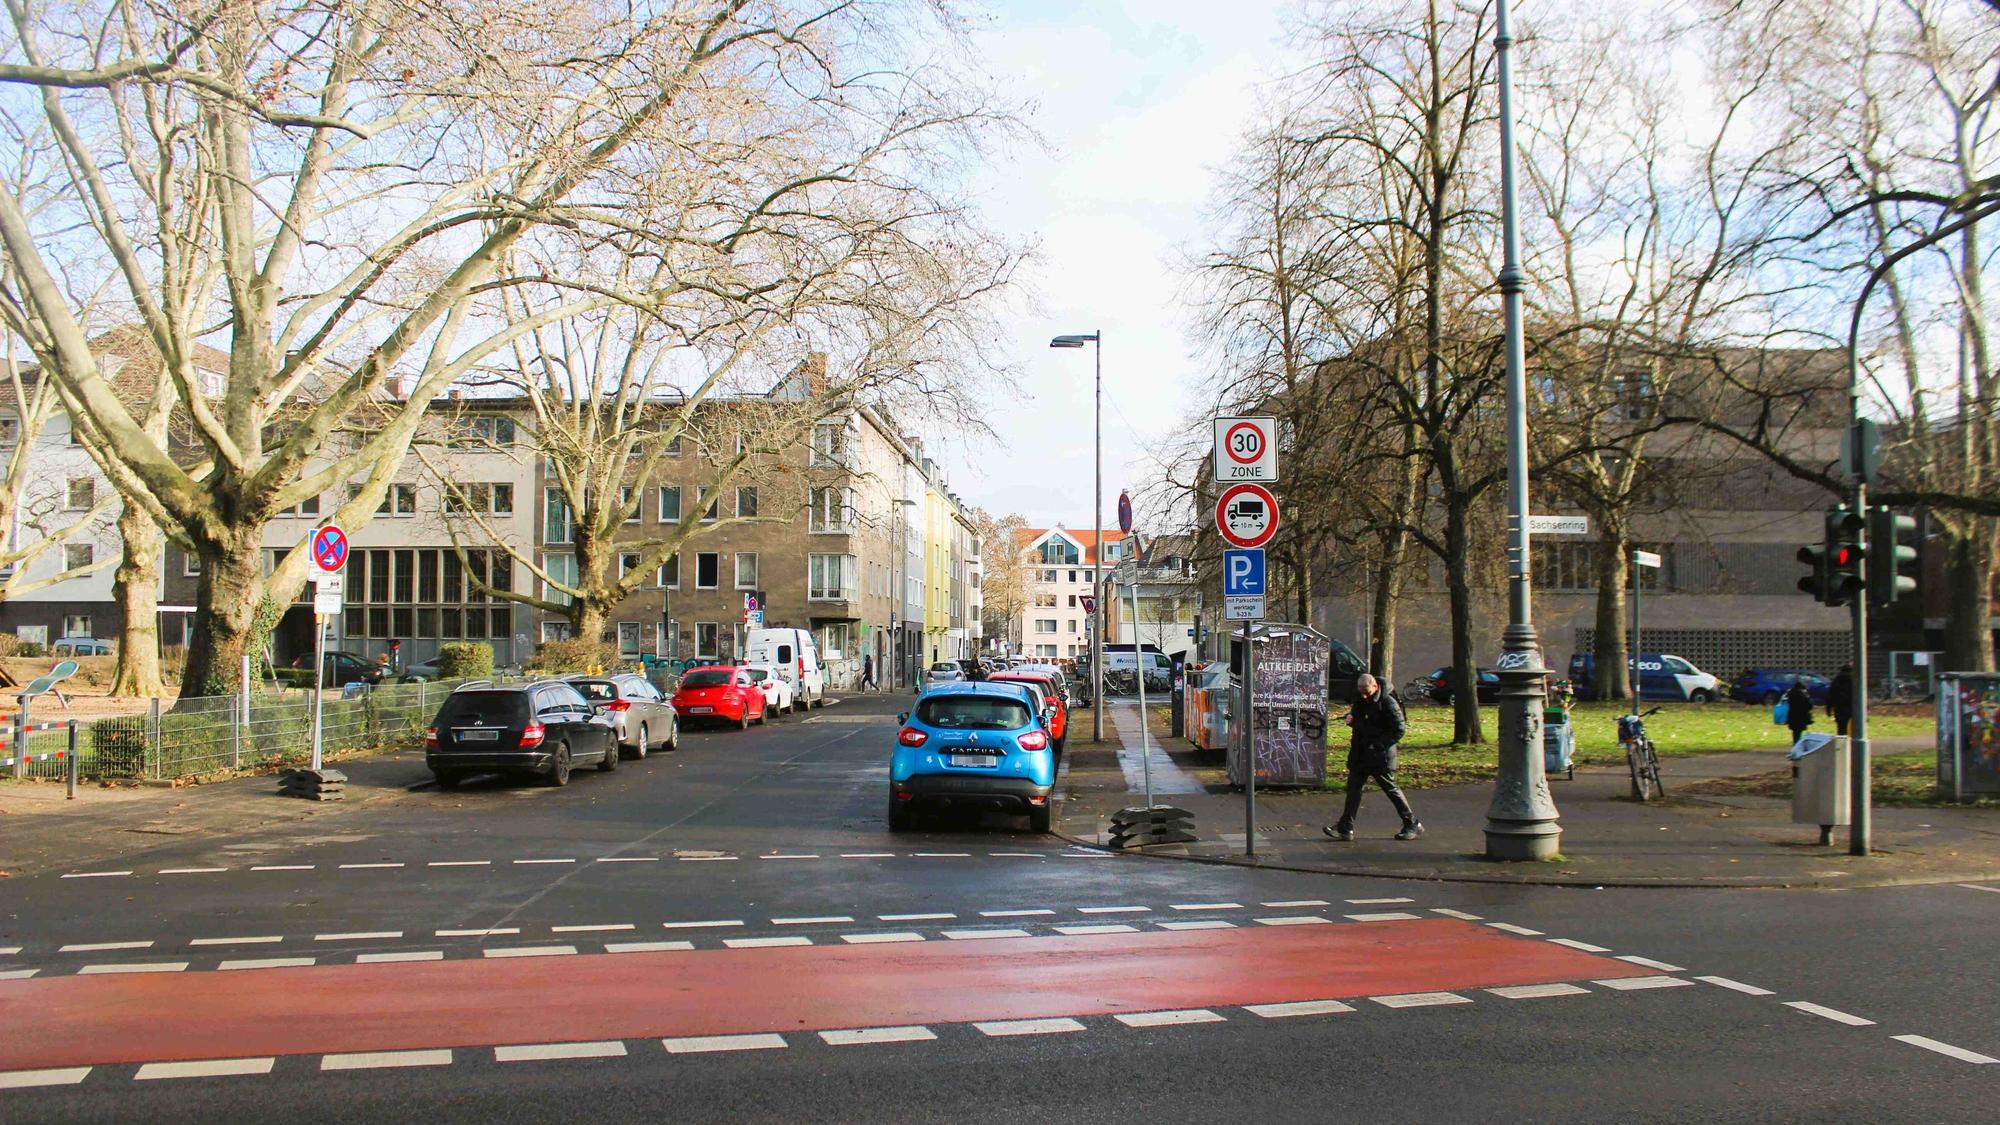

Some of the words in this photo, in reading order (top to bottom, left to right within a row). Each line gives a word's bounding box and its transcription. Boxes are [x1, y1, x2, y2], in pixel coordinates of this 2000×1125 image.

[1234, 434, 1257, 452] 30
[1231, 466, 1262, 477] ZONE
[1529, 519, 1586, 532] Sachsenring
[1231, 555, 1252, 590] P
[1257, 662, 1315, 673] ALTKLEIDER
